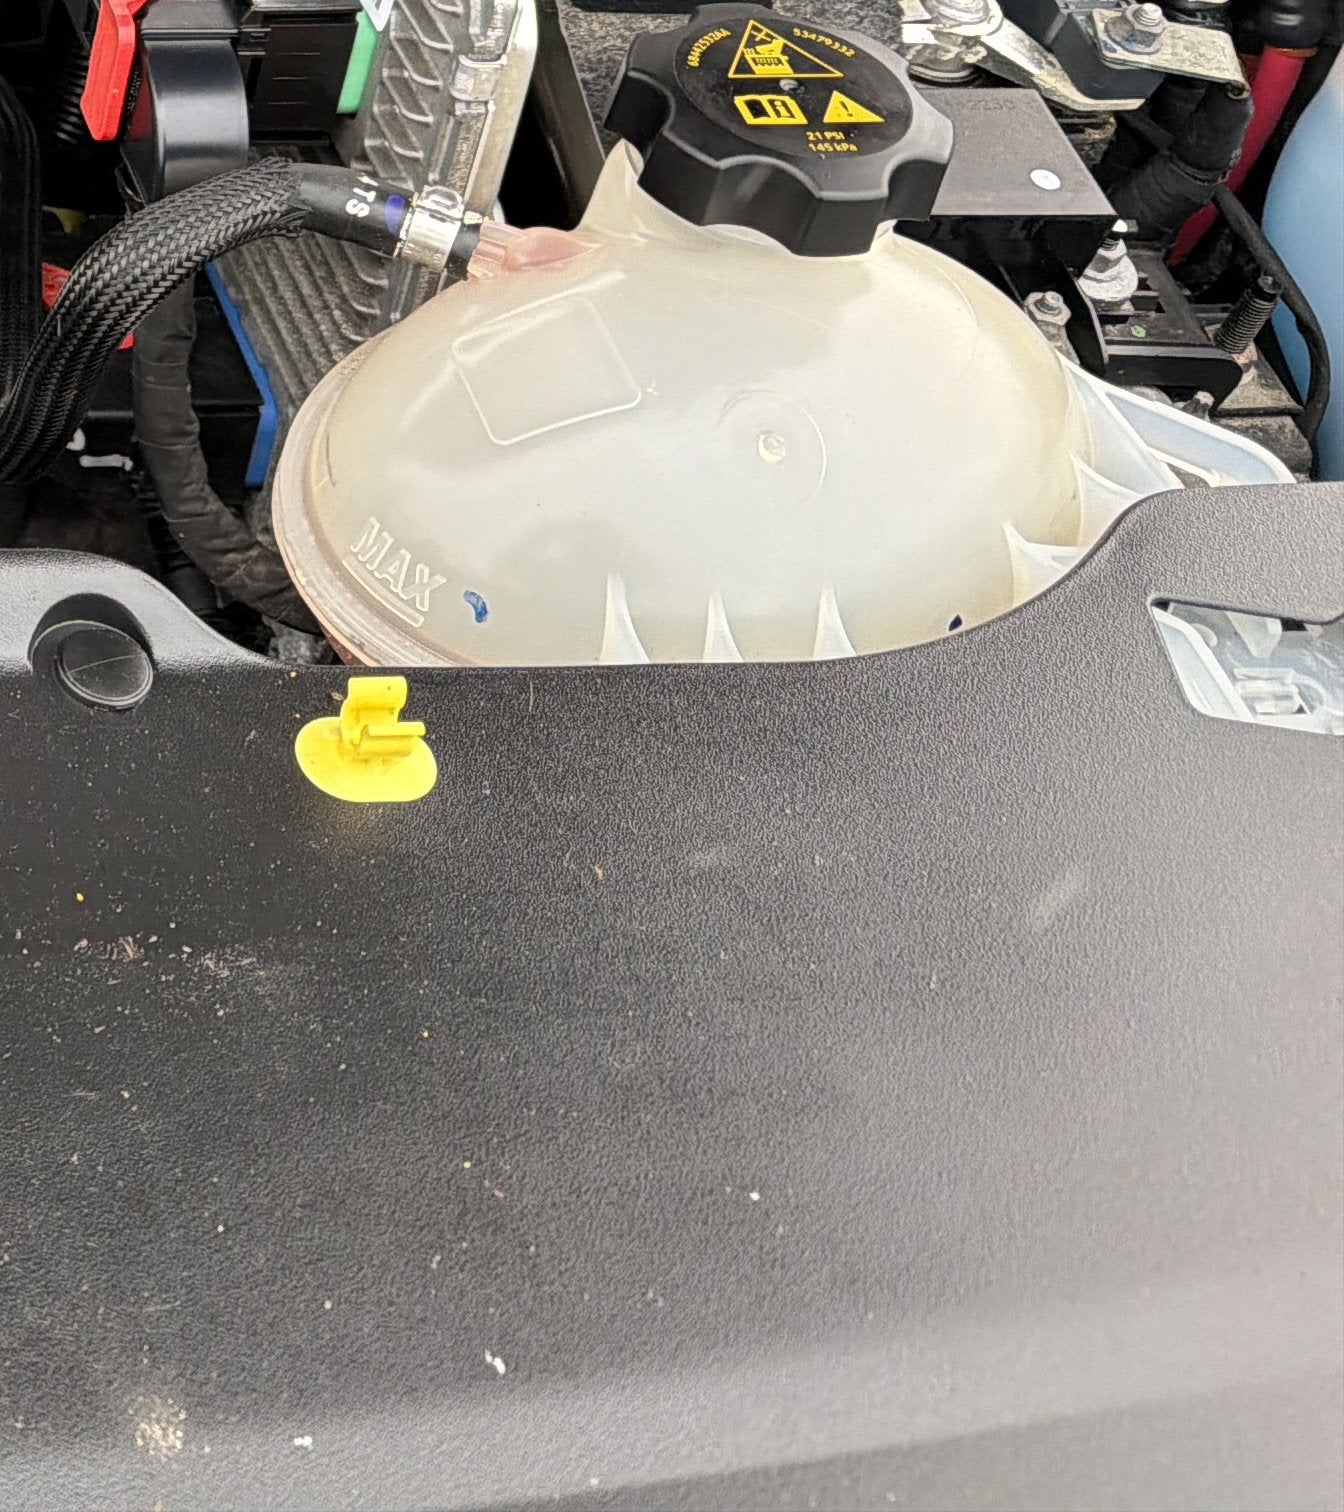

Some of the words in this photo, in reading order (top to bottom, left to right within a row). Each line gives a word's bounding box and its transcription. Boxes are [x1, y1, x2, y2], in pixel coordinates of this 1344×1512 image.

[823, 131, 846, 140] PSI
[808, 142, 833, 152] 145
[833, 142, 859, 152] kPa
[348, 516, 448, 612] MAX
